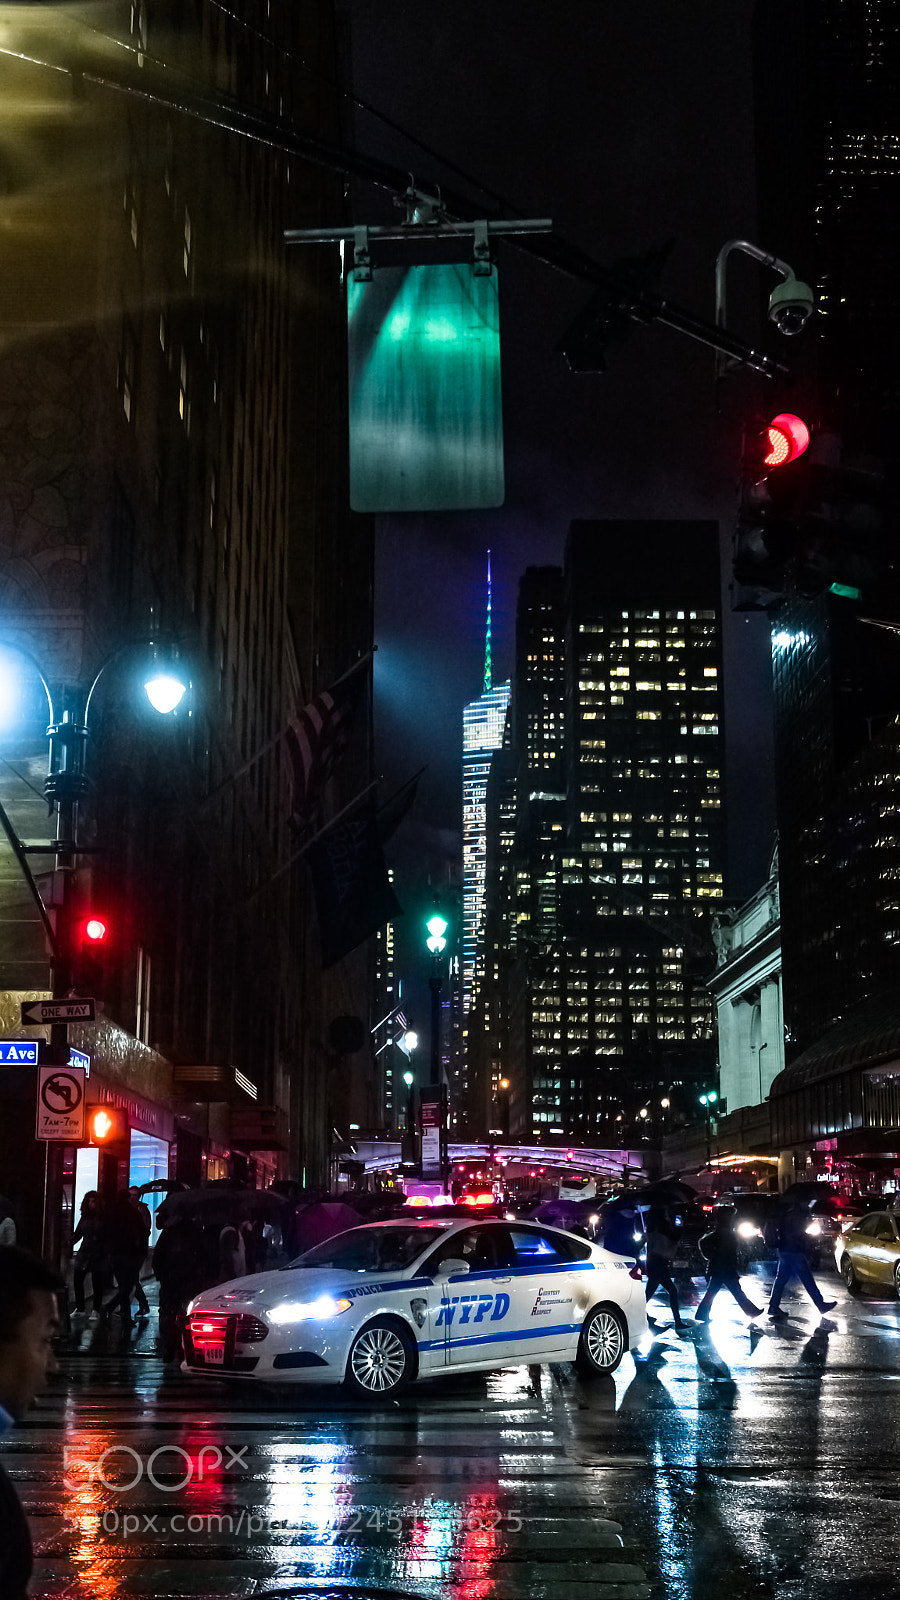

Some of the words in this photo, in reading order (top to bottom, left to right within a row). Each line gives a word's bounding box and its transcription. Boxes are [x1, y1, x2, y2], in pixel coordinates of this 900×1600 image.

[41, 1007, 61, 1017] ONE
[66, 1006, 87, 1016] WAY
[6, 1046, 35, 1060] Ave
[350, 1284, 382, 1298] POLICE
[435, 1293, 510, 1326] NYPD
